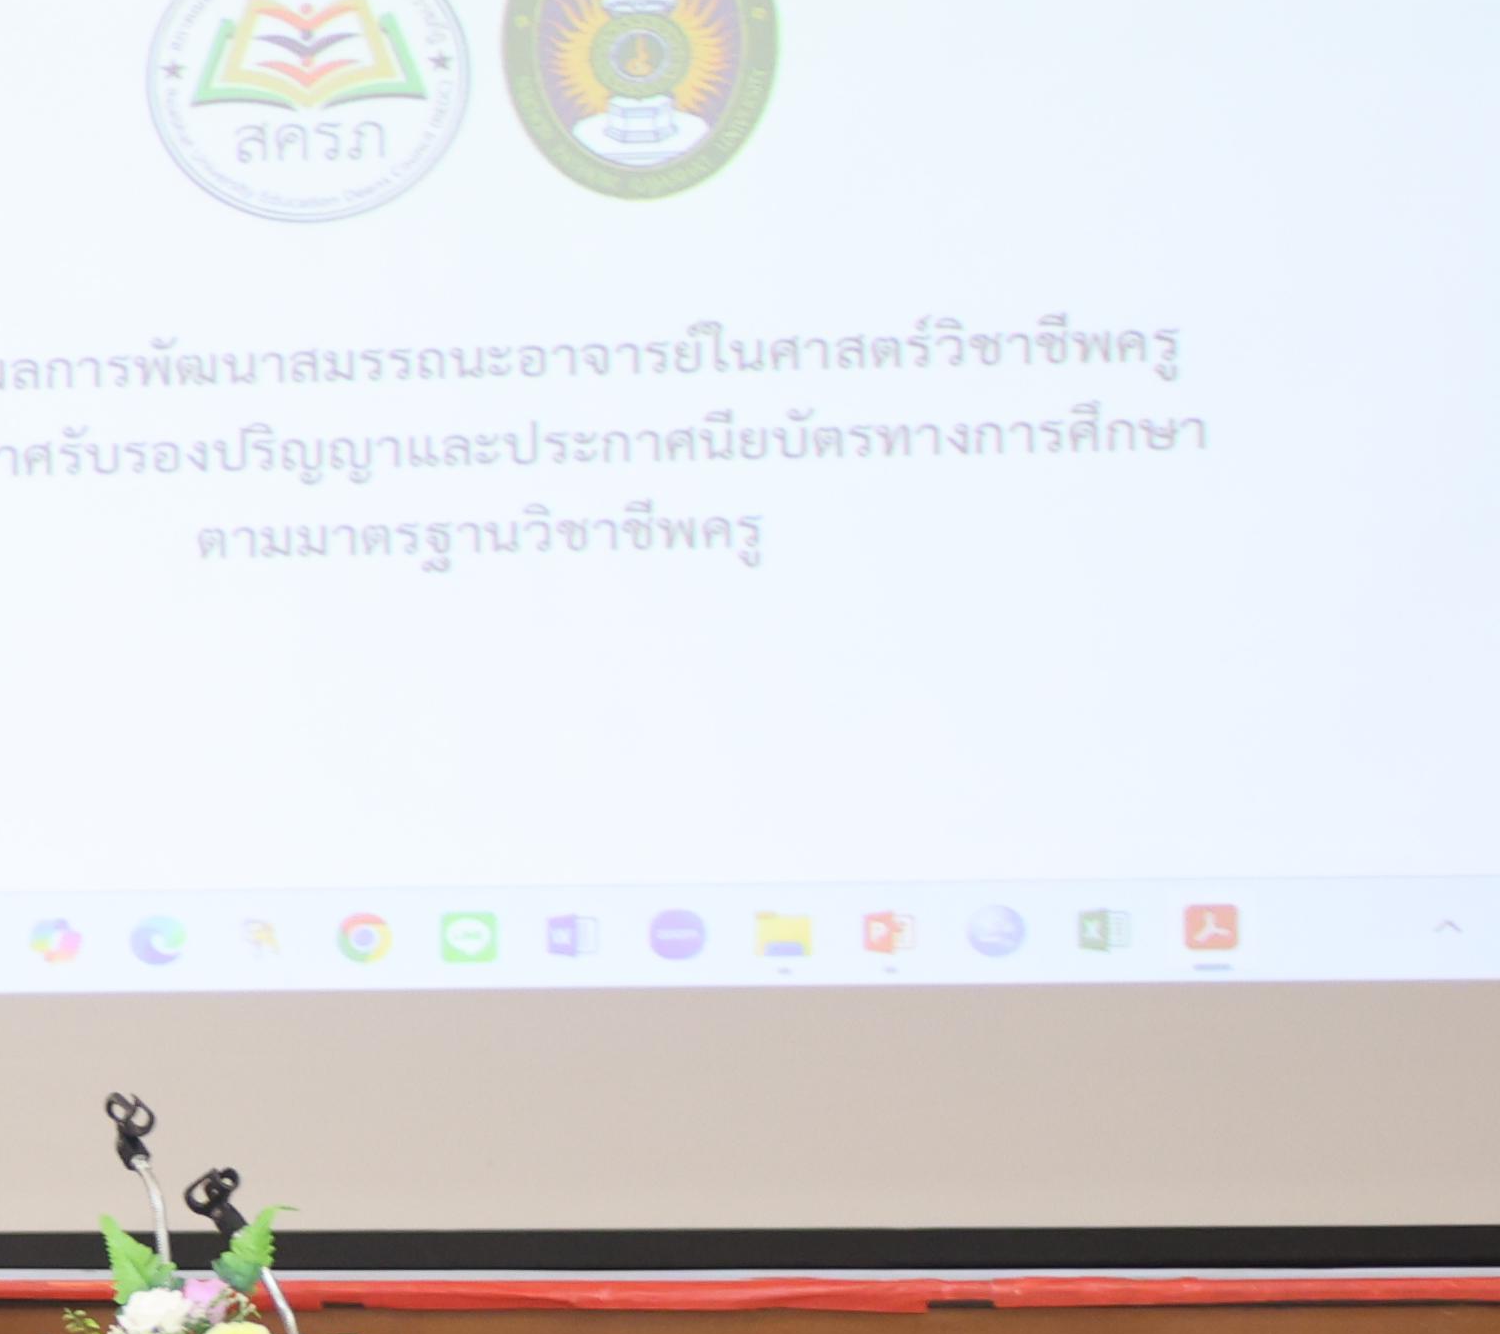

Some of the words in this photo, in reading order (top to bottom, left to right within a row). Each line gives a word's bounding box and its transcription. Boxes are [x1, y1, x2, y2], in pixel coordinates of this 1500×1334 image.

[235, 120, 386, 165] สครภ
[196, 499, 763, 574] ตามมาตรฐานวิชาชีพครู
